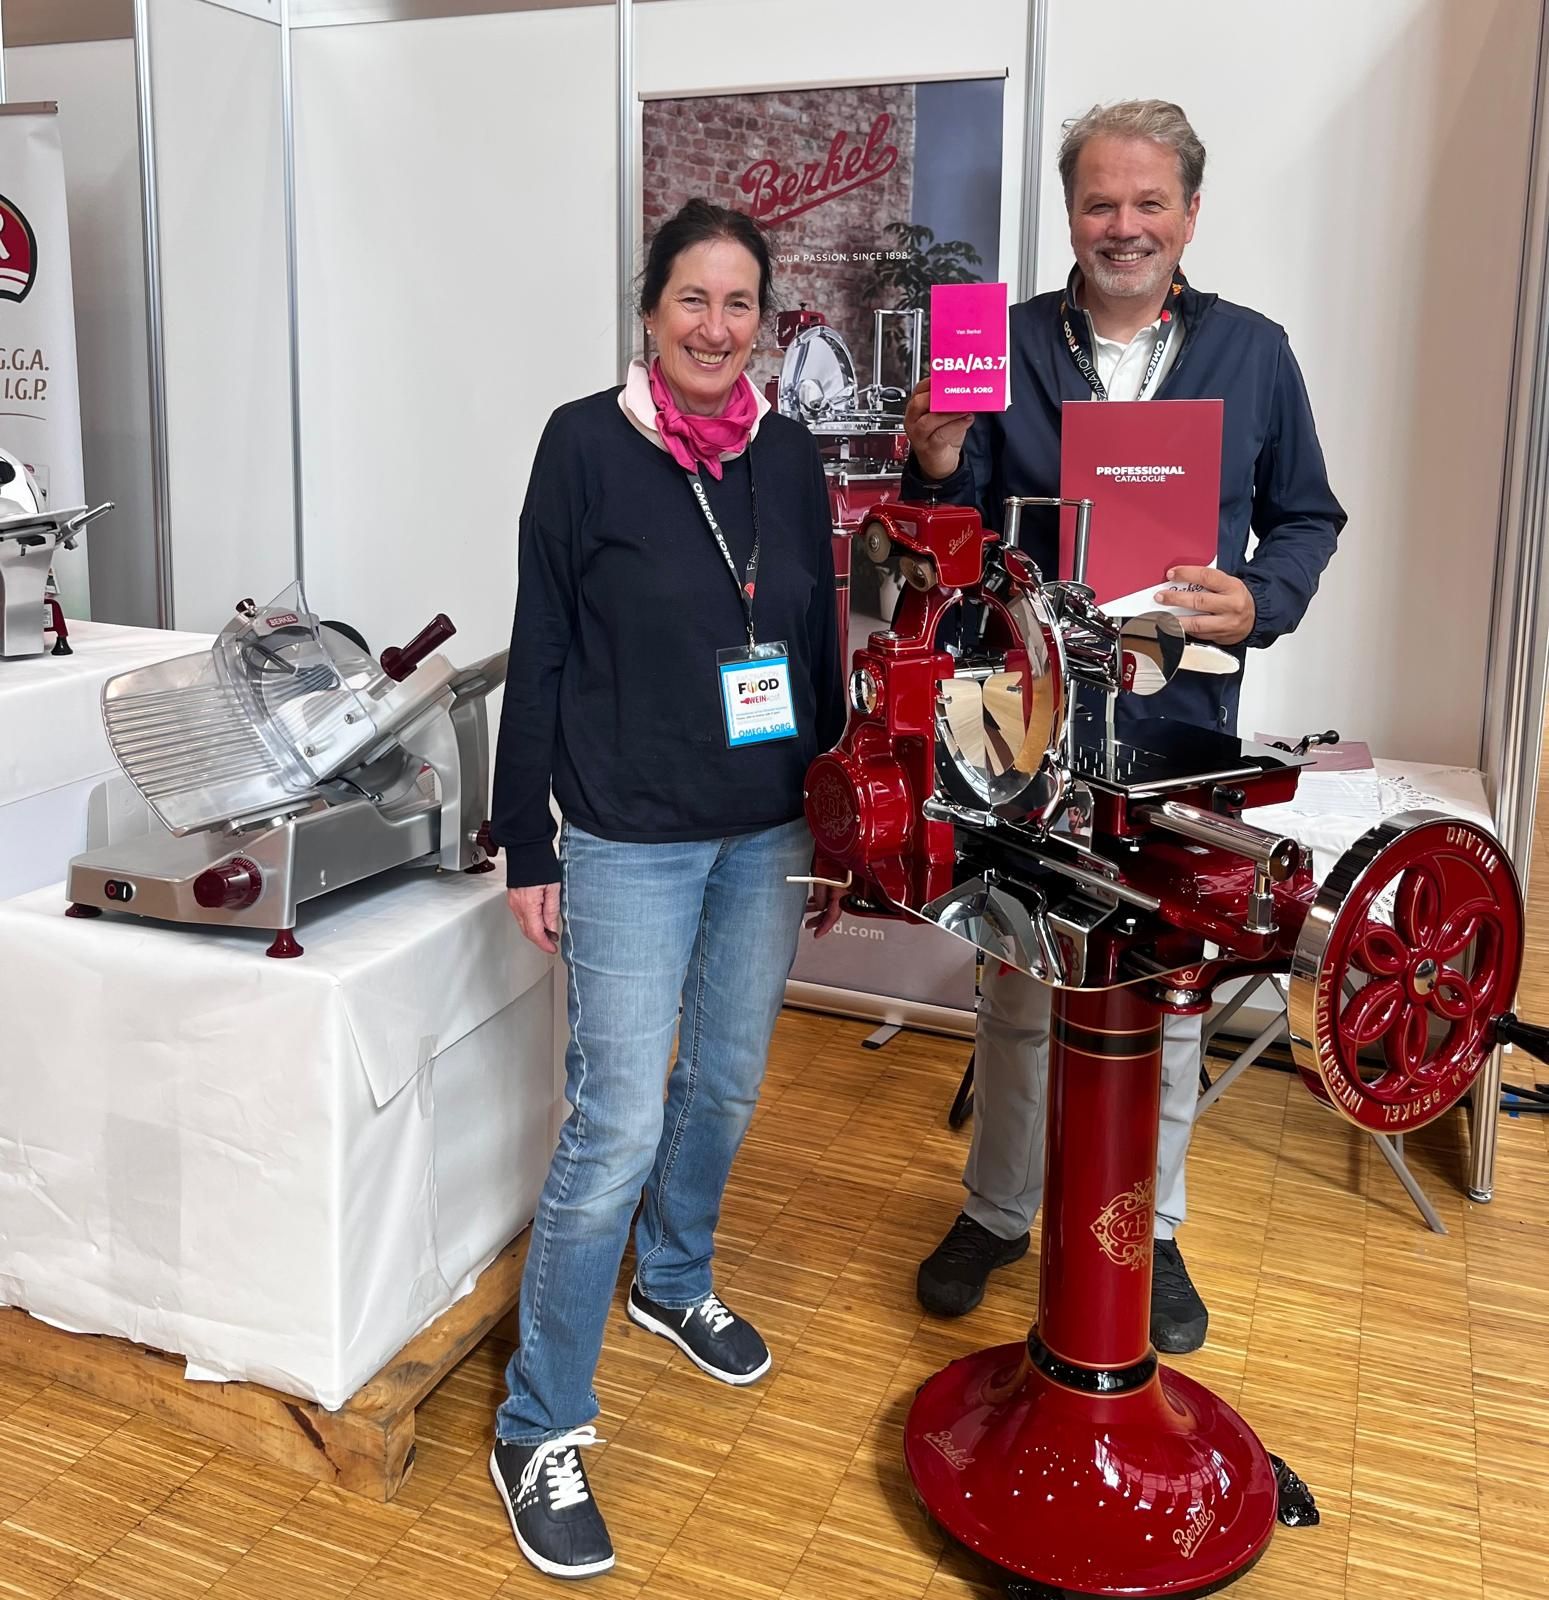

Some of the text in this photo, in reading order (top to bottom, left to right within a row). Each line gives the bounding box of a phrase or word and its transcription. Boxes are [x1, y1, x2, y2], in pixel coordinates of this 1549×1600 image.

[741, 113, 898, 229] Berkel
[803, 252, 850, 263] PASSION,
[852, 252, 882, 261] SINCE
[931, 353, 1008, 375] CBA/A3.7
[1143, 340, 1165, 386] OMEGA
[4, 377, 47, 400] I.G.P.
[944, 386, 994, 395] OMEGA SORG
[1096, 466, 1185, 475] PROFESSIONAL
[1114, 475, 1167, 483] CATALOGUE
[693, 482, 735, 569] OMEGA SORG
[269, 614, 297, 626] BERKEL
[738, 722, 791, 738] OMEGA SORG
[1446, 826, 1499, 874] MILANO
[829, 921, 885, 941] d.com
[1316, 962, 1364, 1114] INTERNATIONAL
[1382, 1088, 1441, 1123] BERKEL
[923, 1430, 976, 1470] Berkel
[1172, 1499, 1215, 1559] Berkel
